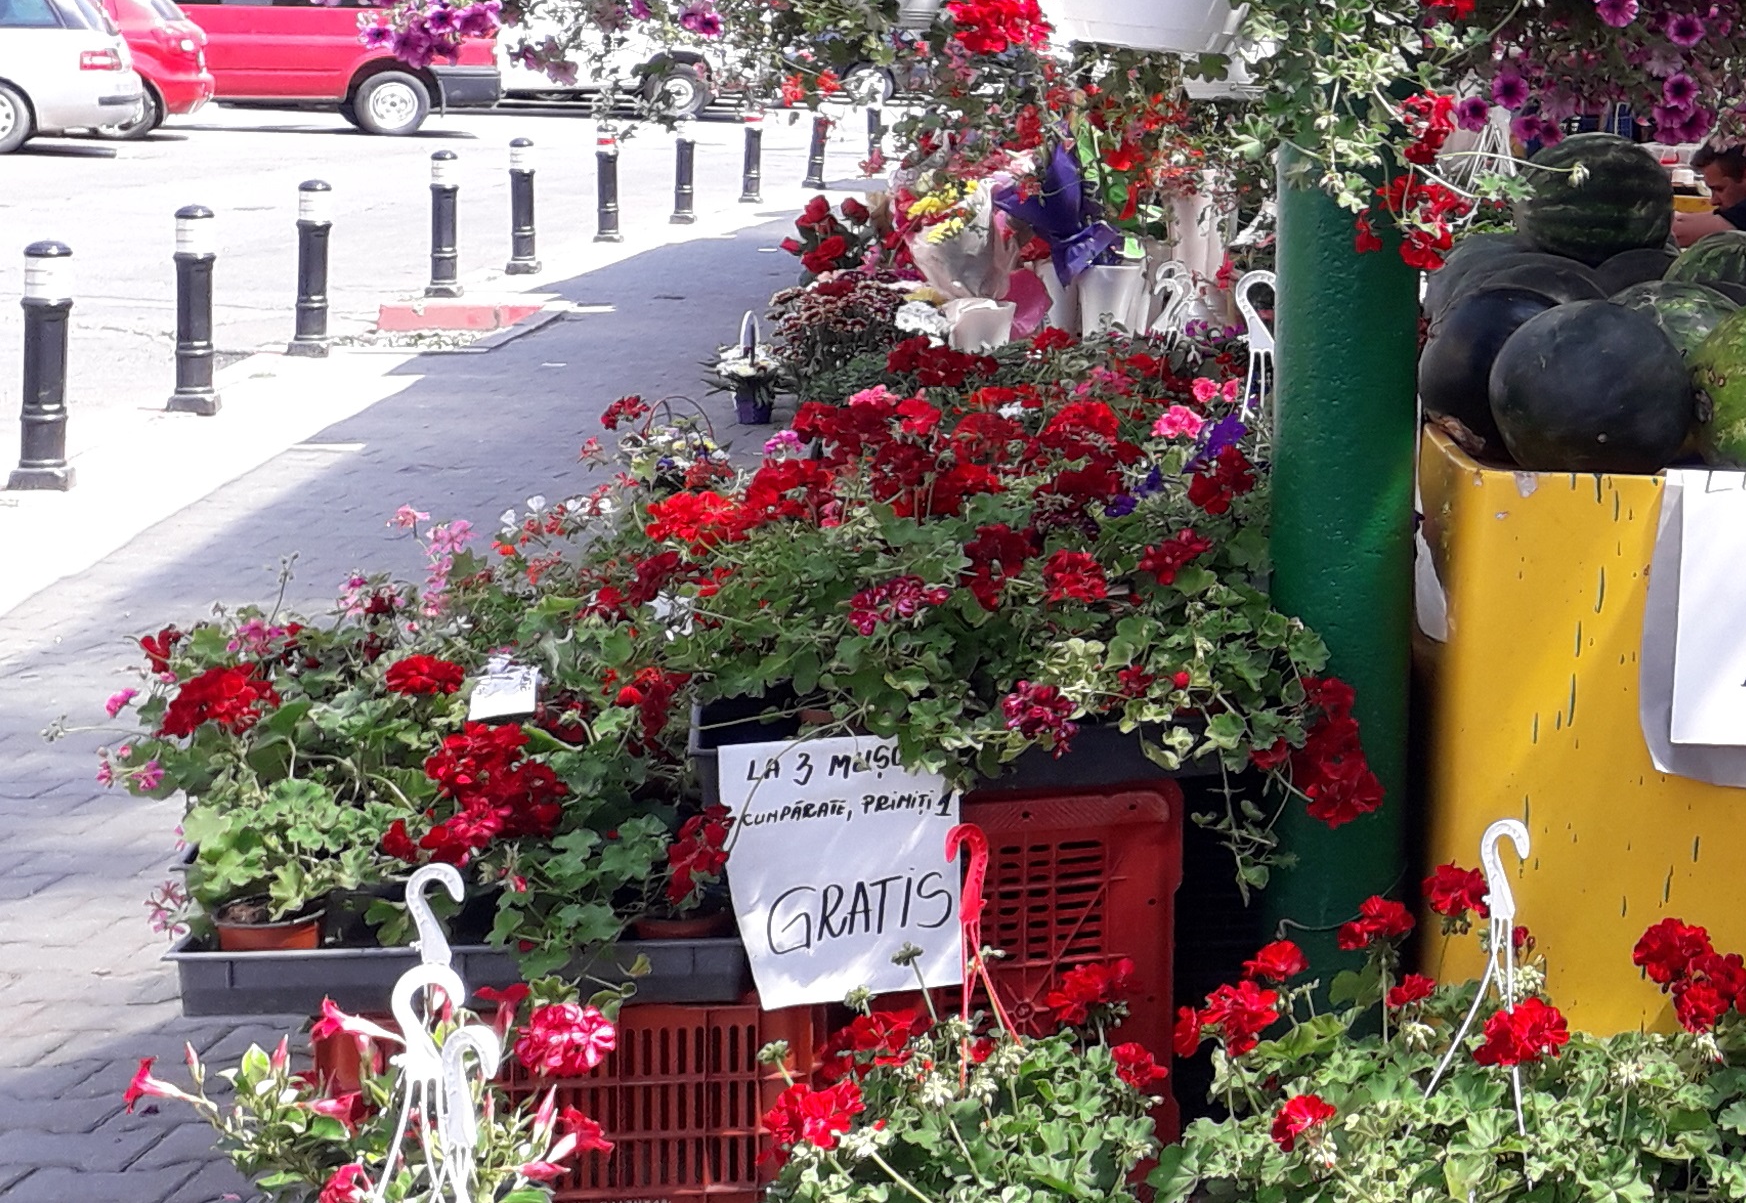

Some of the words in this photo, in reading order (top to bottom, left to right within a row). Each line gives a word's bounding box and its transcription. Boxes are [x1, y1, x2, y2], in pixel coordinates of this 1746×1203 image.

[747, 758, 780, 781] LA
[793, 752, 813, 786] 3
[767, 867, 952, 955] GRATIS
